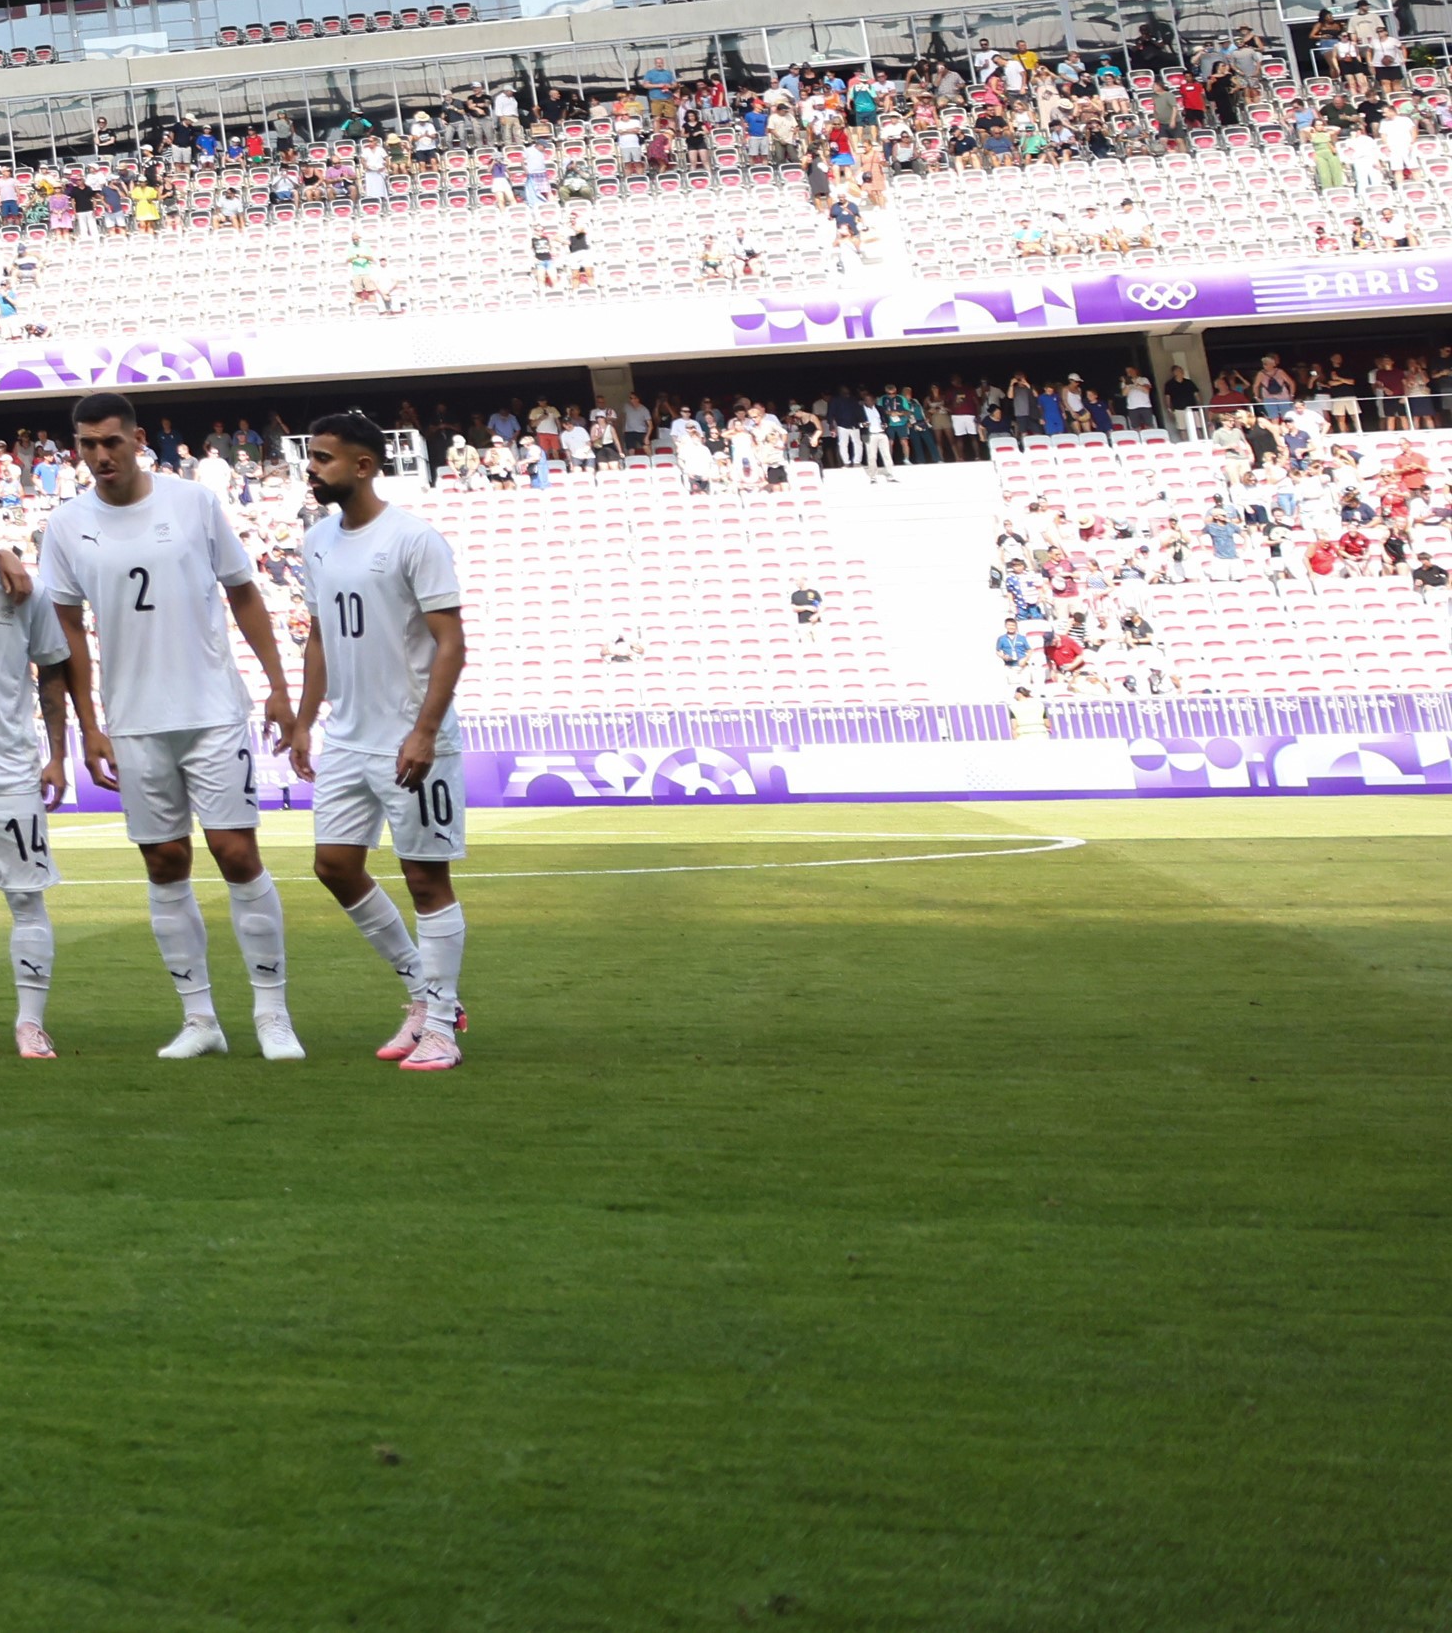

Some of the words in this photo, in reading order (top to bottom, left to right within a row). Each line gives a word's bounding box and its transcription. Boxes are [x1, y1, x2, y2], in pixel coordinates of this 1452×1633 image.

[129, 567, 155, 612] 2
[335, 592, 363, 638] 10
[238, 749, 254, 795] 2
[415, 779, 452, 826] 10
[5, 814, 47, 861] 14
